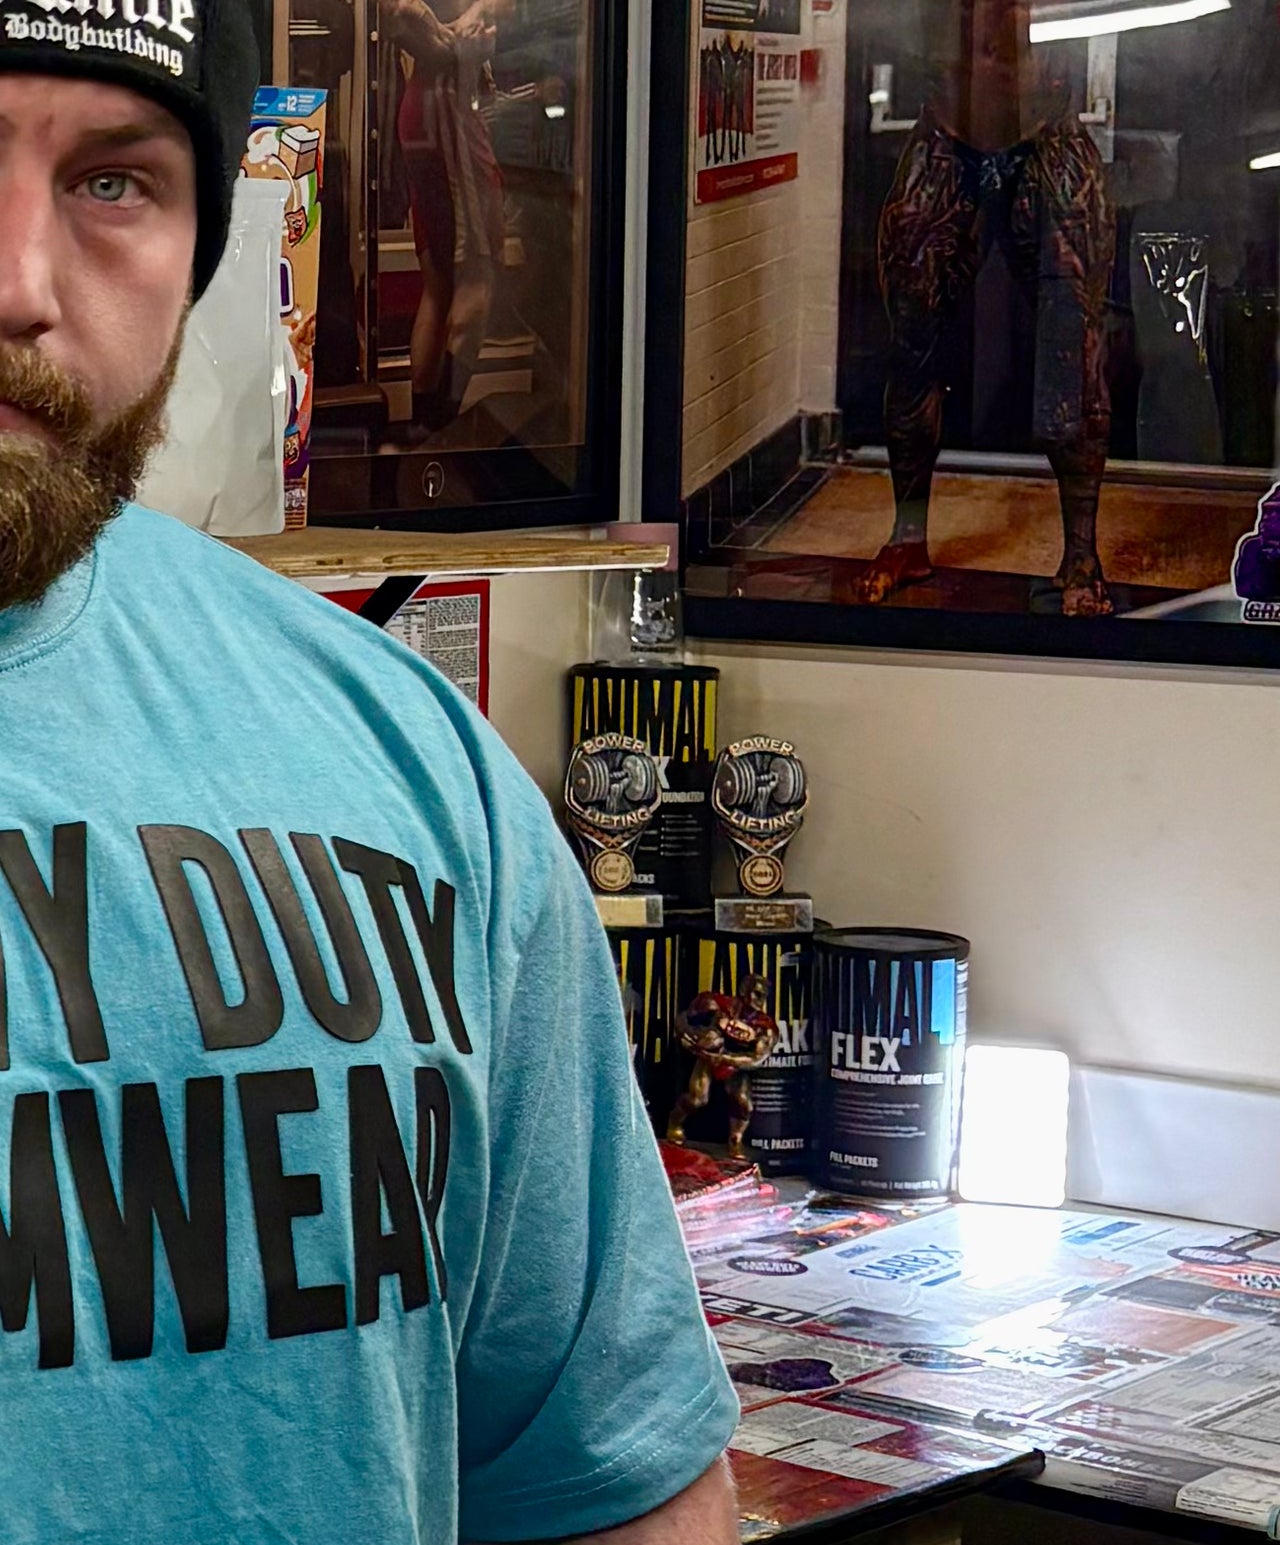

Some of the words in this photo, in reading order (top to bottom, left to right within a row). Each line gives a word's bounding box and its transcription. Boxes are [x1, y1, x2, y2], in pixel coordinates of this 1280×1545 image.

[3, 12, 185, 77] Bodybuilding
[582, 734, 645, 755] POWER
[728, 736, 794, 757] POWER
[585, 807, 650, 828] LIFTING
[729, 809, 801, 831] LIFTING
[137, 822, 474, 1056] DUTY
[771, 1019, 809, 1055] AK
[830, 1030, 902, 1073] FLEX
